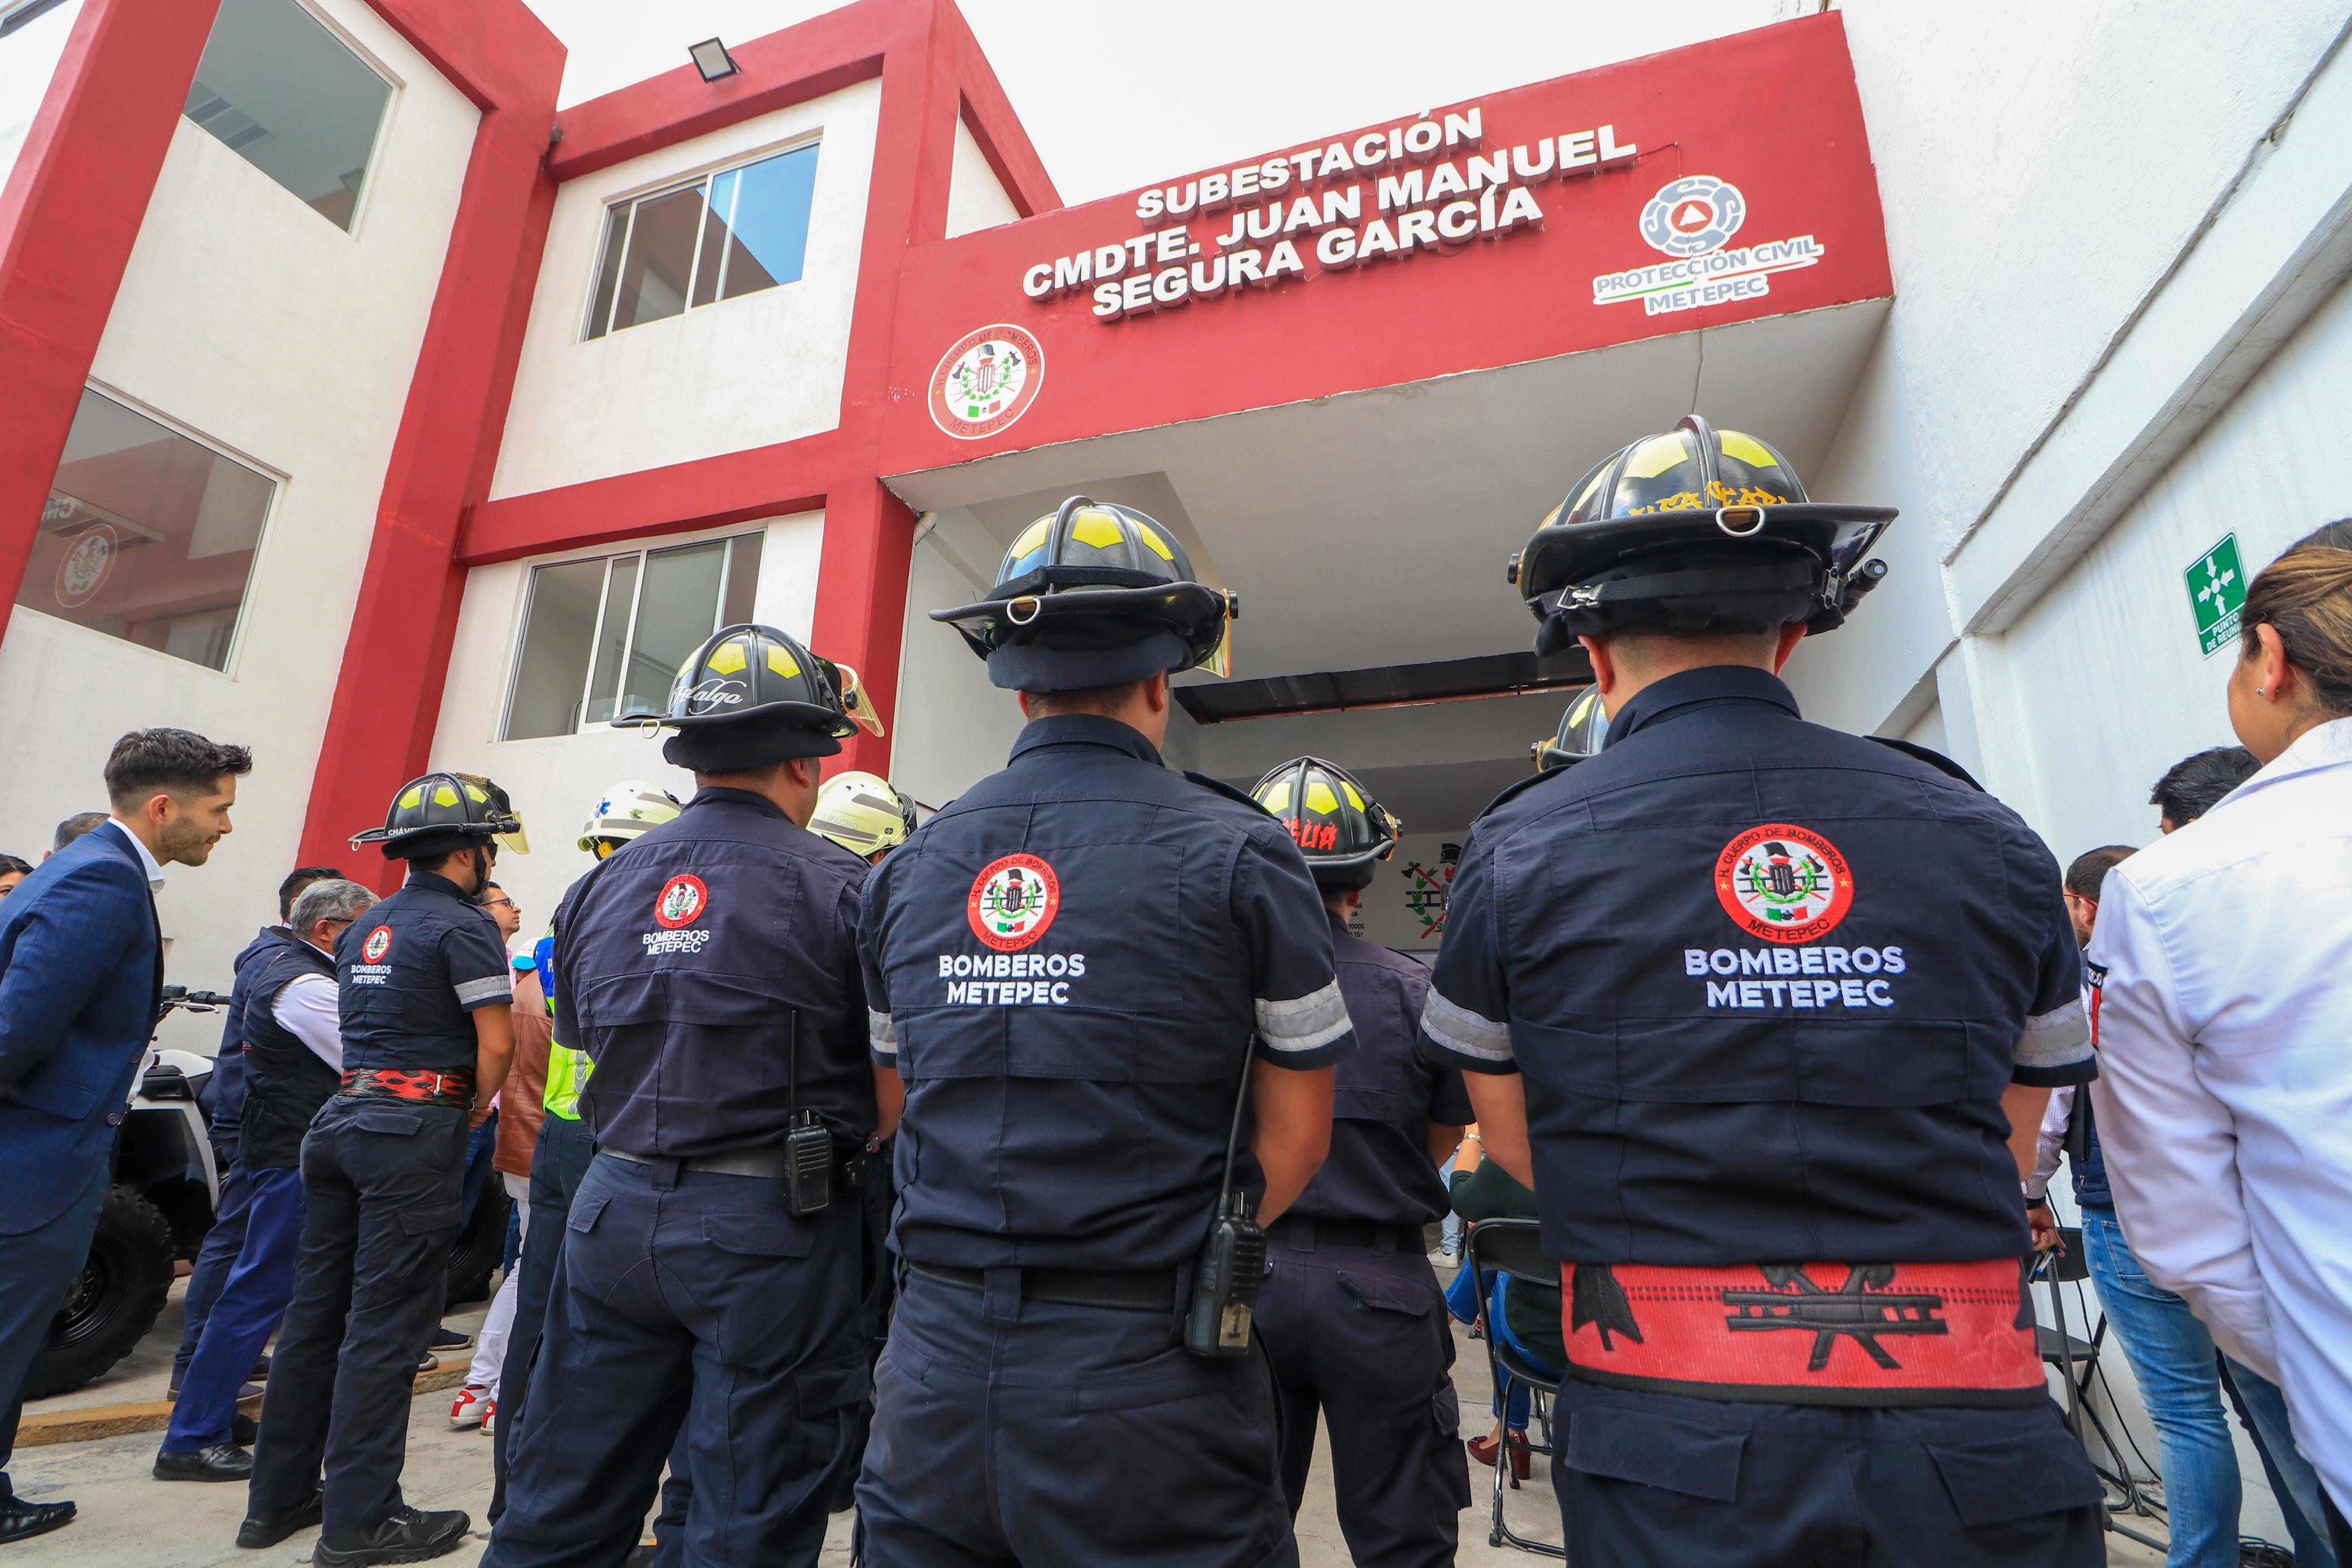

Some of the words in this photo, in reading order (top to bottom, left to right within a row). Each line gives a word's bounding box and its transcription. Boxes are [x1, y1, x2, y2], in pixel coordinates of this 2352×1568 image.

[1135, 107, 1484, 220] SUBESTACIÓN
[1022, 225, 1201, 300] CMDTE.
[1216, 185, 1361, 249] JUAN
[1378, 124, 1636, 214] MANUEL
[1092, 244, 1304, 319] SEGURA
[1316, 180, 1544, 268] GARCÍA
[1597, 252, 1747, 292] PROTECCIÓN
[1754, 240, 1818, 263] CIVIL
[1649, 277, 1765, 312] METEPEC
[940, 339, 976, 375] CUERPO
[979, 331, 993, 343] DE
[996, 330, 1038, 366] BOMBEROS
[950, 409, 1014, 434] METEPEC
[2212, 612, 2239, 636] PUNTO
[2206, 638, 2217, 651] DE
[1723, 831, 1761, 865] CUERPO
[1764, 827, 1783, 838] DE
[1788, 829, 1847, 875] BOMBEROS
[978, 860, 1008, 886] CUERPO
[1026, 857, 1057, 894] BOMBEROS
[642, 930, 710, 945] BOMBEROS
[982, 930, 1037, 948] METEPEC
[1746, 918, 1831, 941] METEPEC
[647, 941, 701, 955] METEPEC
[1684, 946, 1907, 977] BOMBEROS
[351, 964, 392, 974] BOMBEROS
[352, 974, 387, 984] METEPEC
[939, 953, 1086, 978] BOMBEROS
[946, 981, 1070, 1006] METEPEC
[1706, 978, 1895, 1009] METEPEC
[1227, 1309, 1240, 1339] 1
